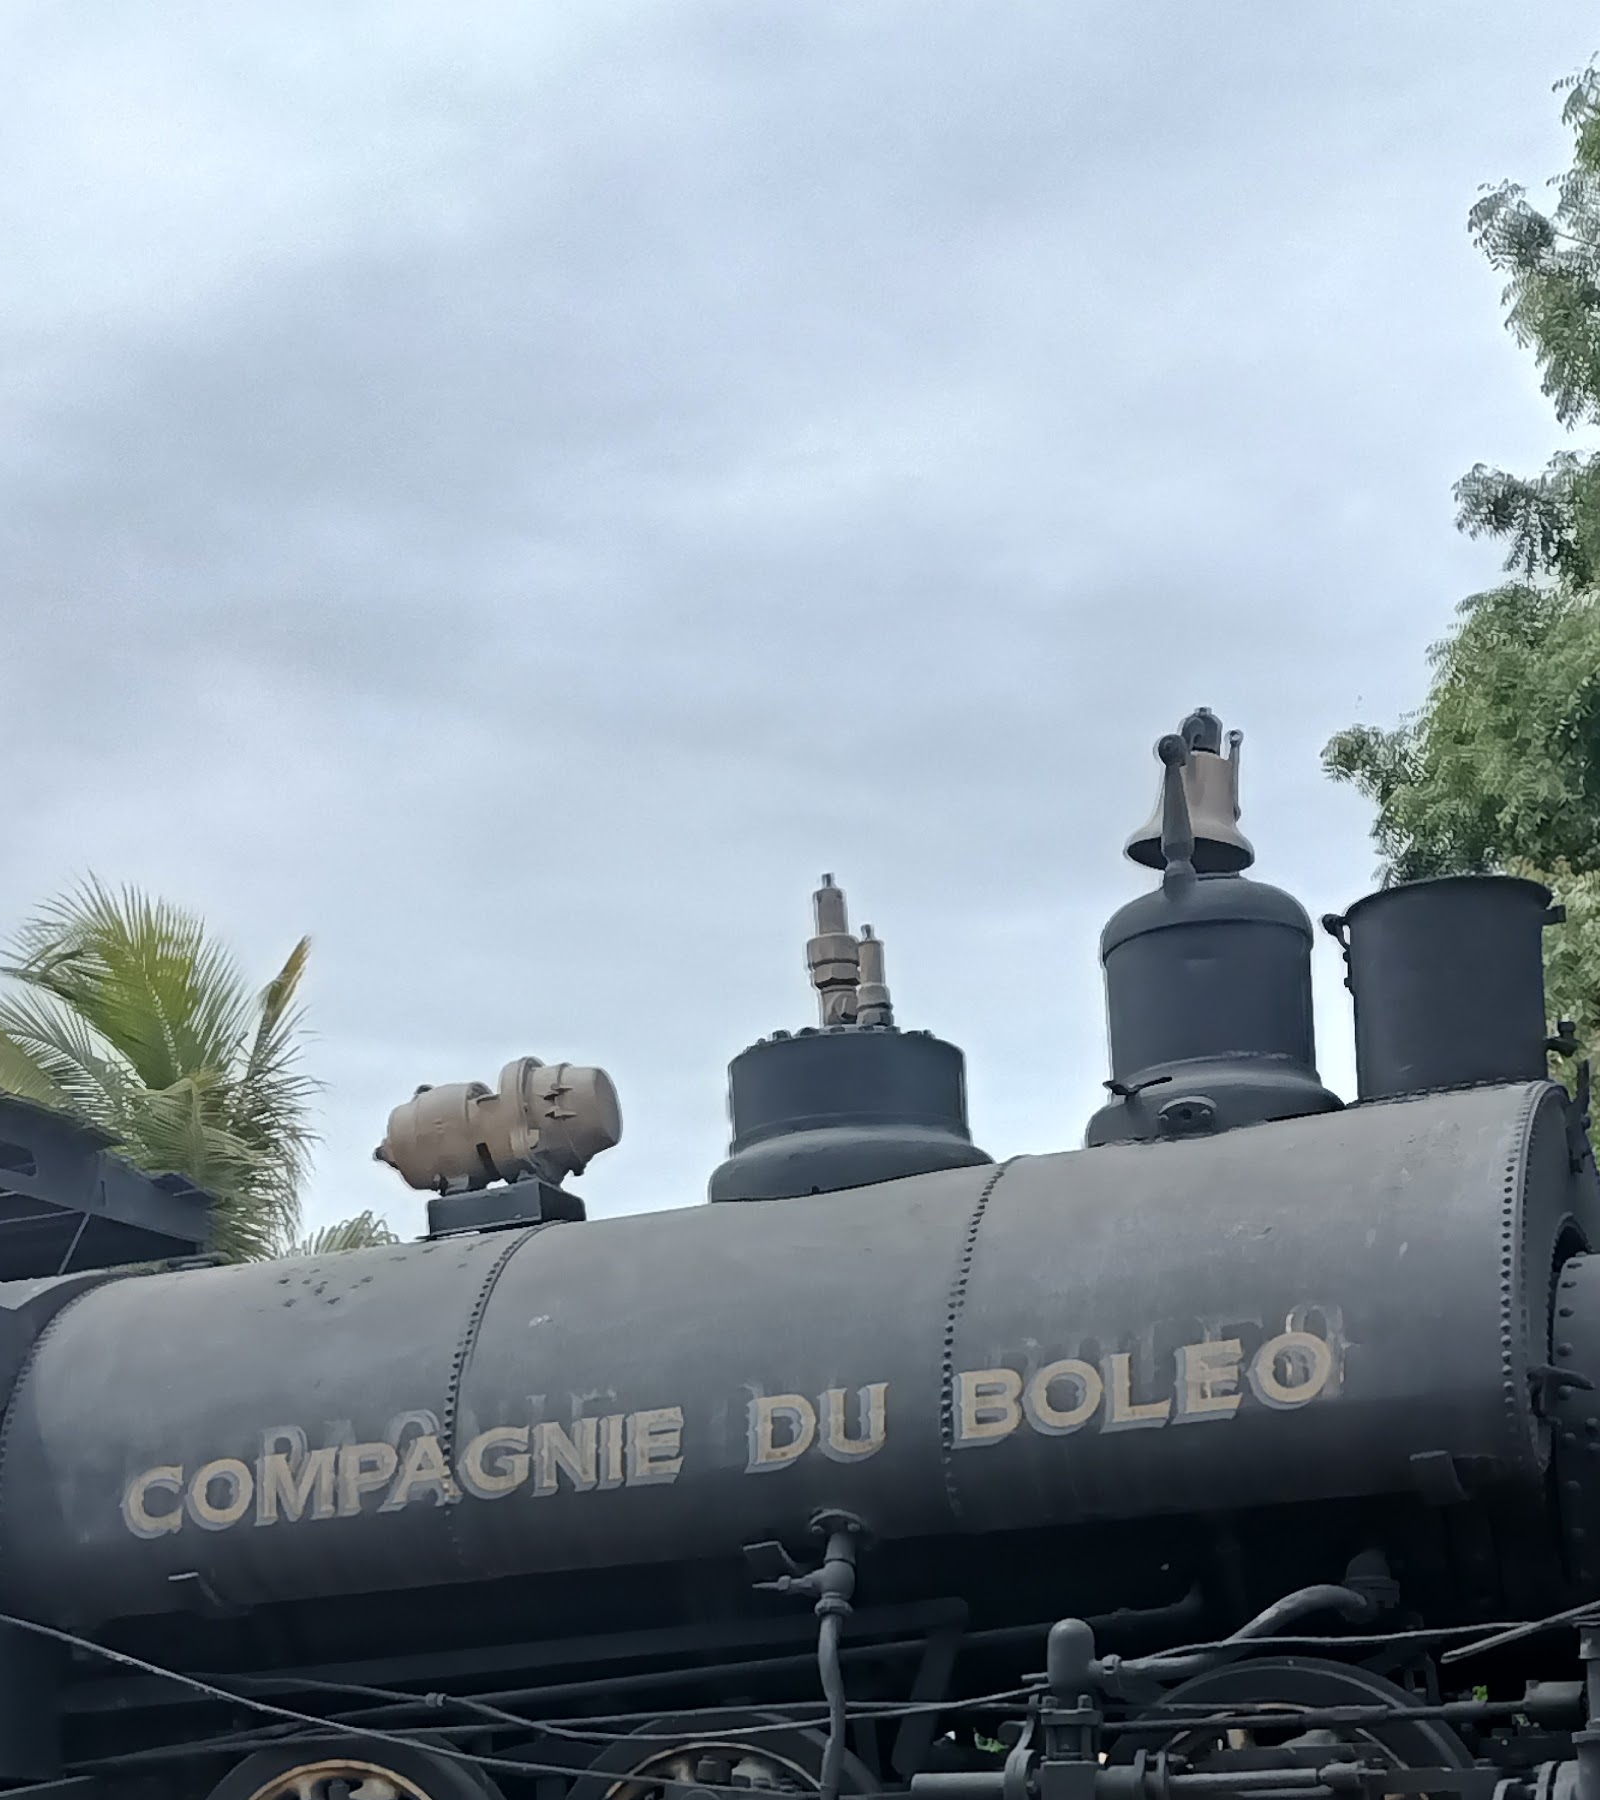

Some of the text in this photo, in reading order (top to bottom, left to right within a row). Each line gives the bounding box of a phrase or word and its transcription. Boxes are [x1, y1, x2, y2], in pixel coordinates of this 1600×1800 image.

[122, 1331, 1333, 1539] COMPAGNIE DU BOLEO
